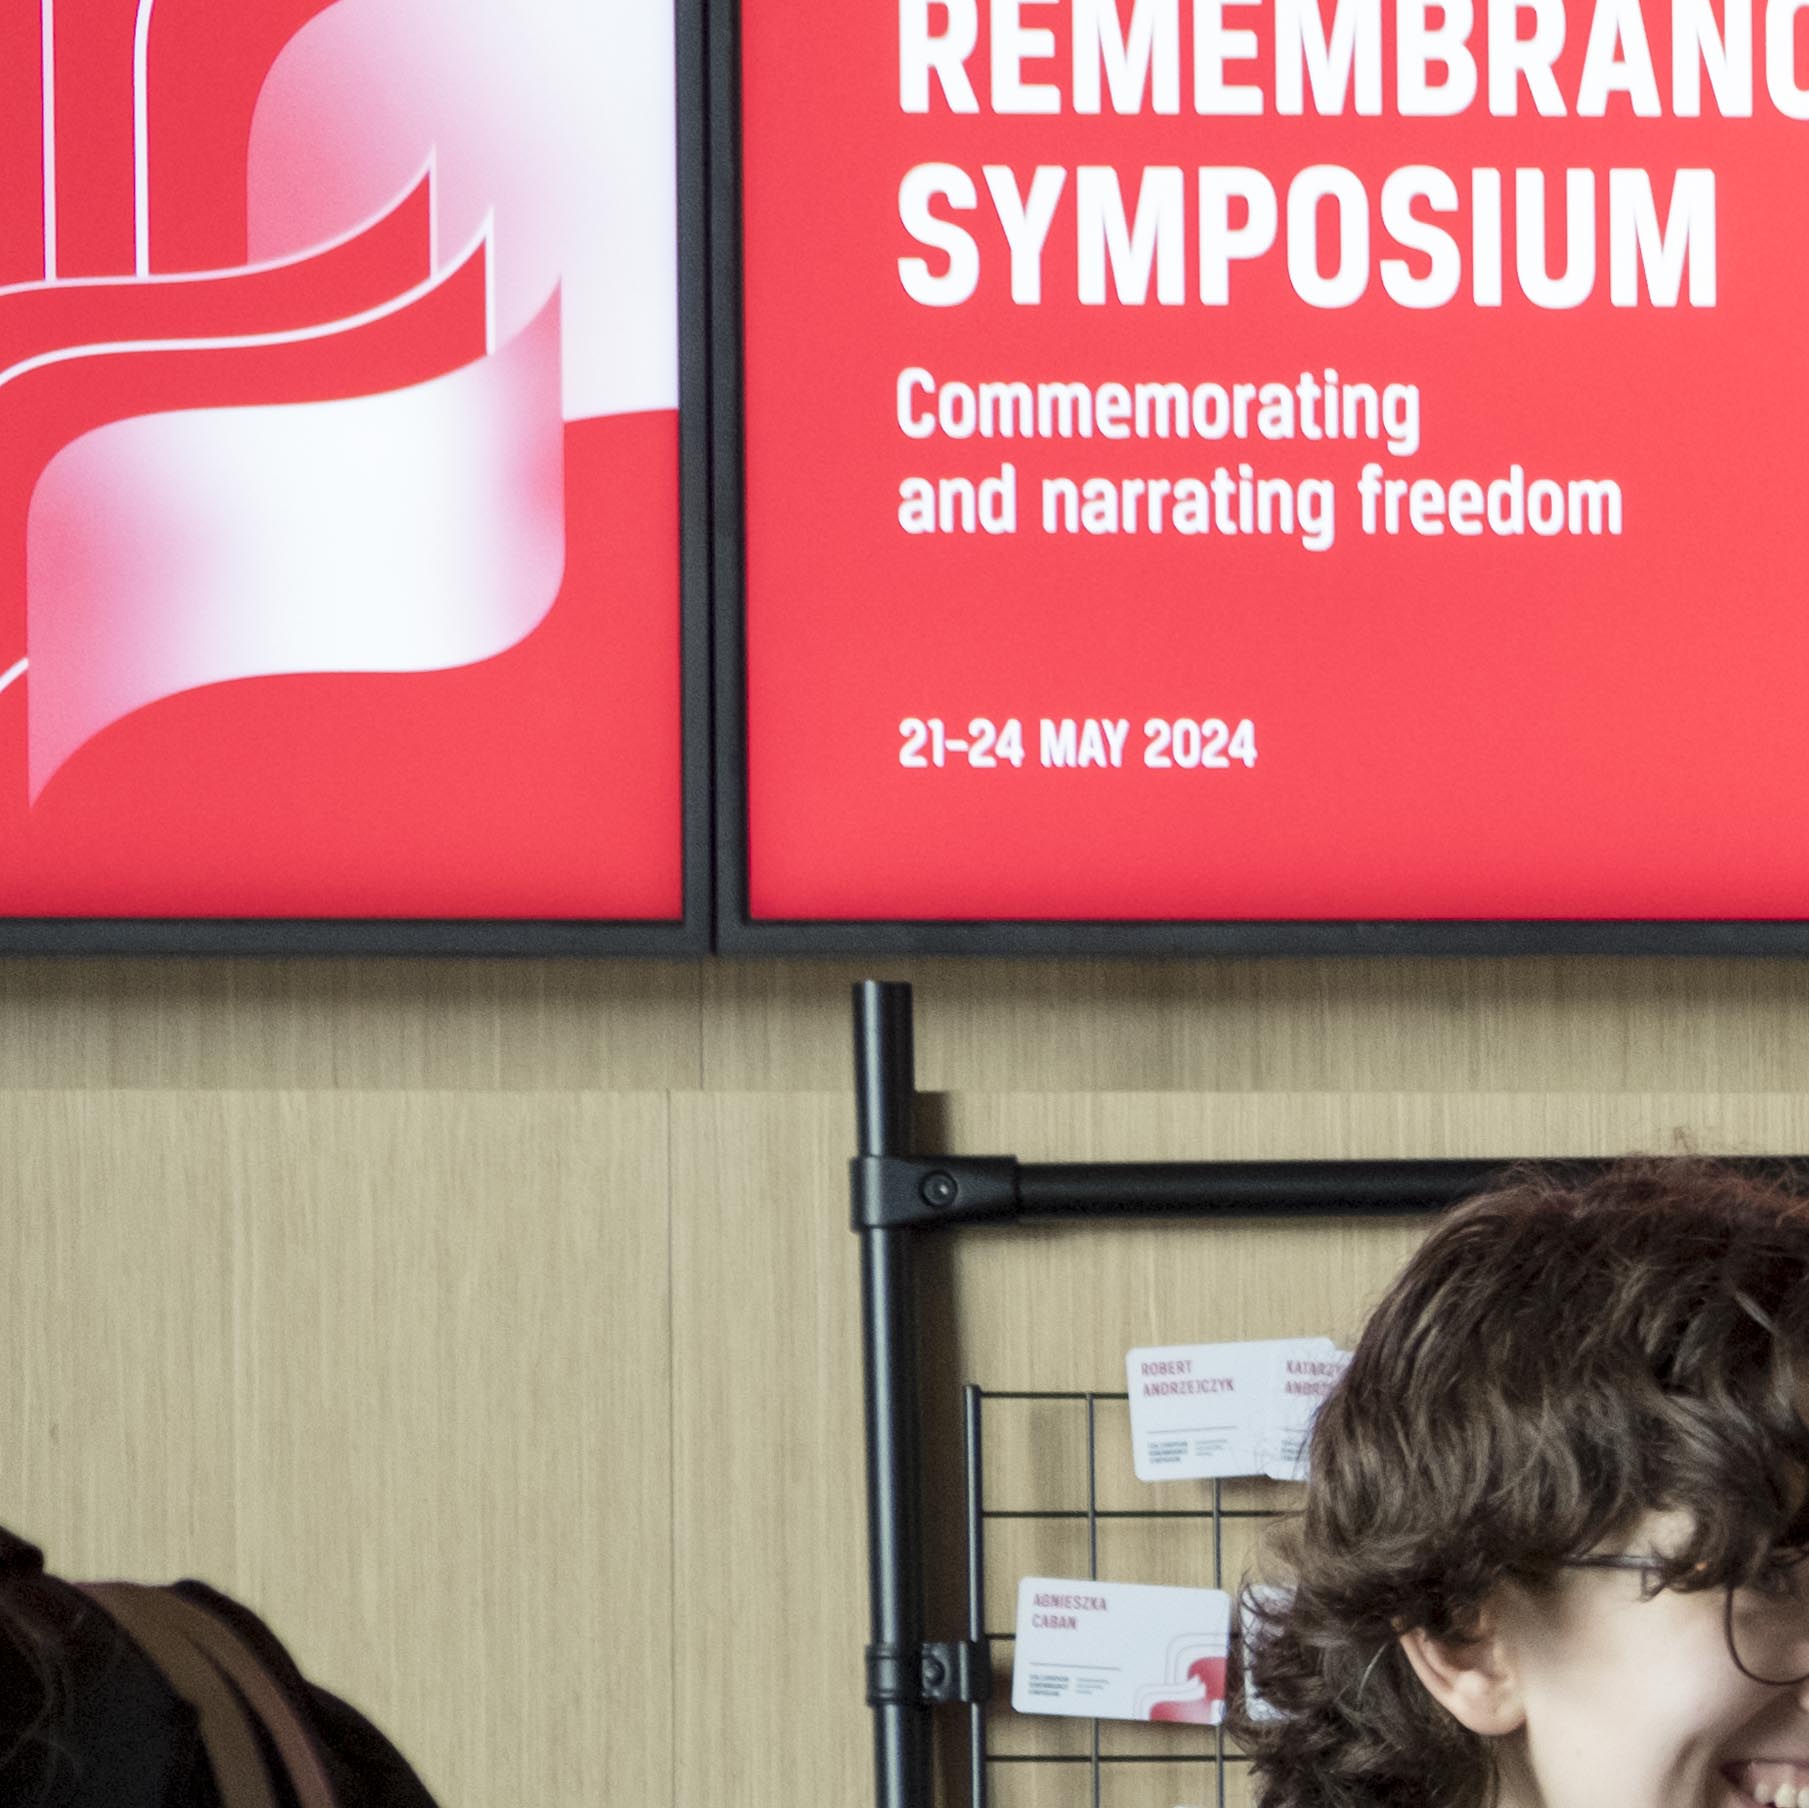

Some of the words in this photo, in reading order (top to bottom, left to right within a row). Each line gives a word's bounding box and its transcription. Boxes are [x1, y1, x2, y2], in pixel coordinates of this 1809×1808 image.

[897, 162, 1717, 309] SYMPOSIUM
[896, 366, 1420, 457] Commemorating
[897, 462, 1017, 535] and
[1042, 463, 1335, 552] narrating
[1357, 463, 1623, 536] freedom
[1039, 718, 1130, 768] MAY
[1143, 717, 1258, 769] 2024
[1141, 1360, 1192, 1376] ROBERT
[1143, 1378, 1234, 1397] ANDRZEJCZYK
[1033, 1593, 1107, 1611] AGNIESZKA
[1032, 1613, 1077, 1630] CABAN
